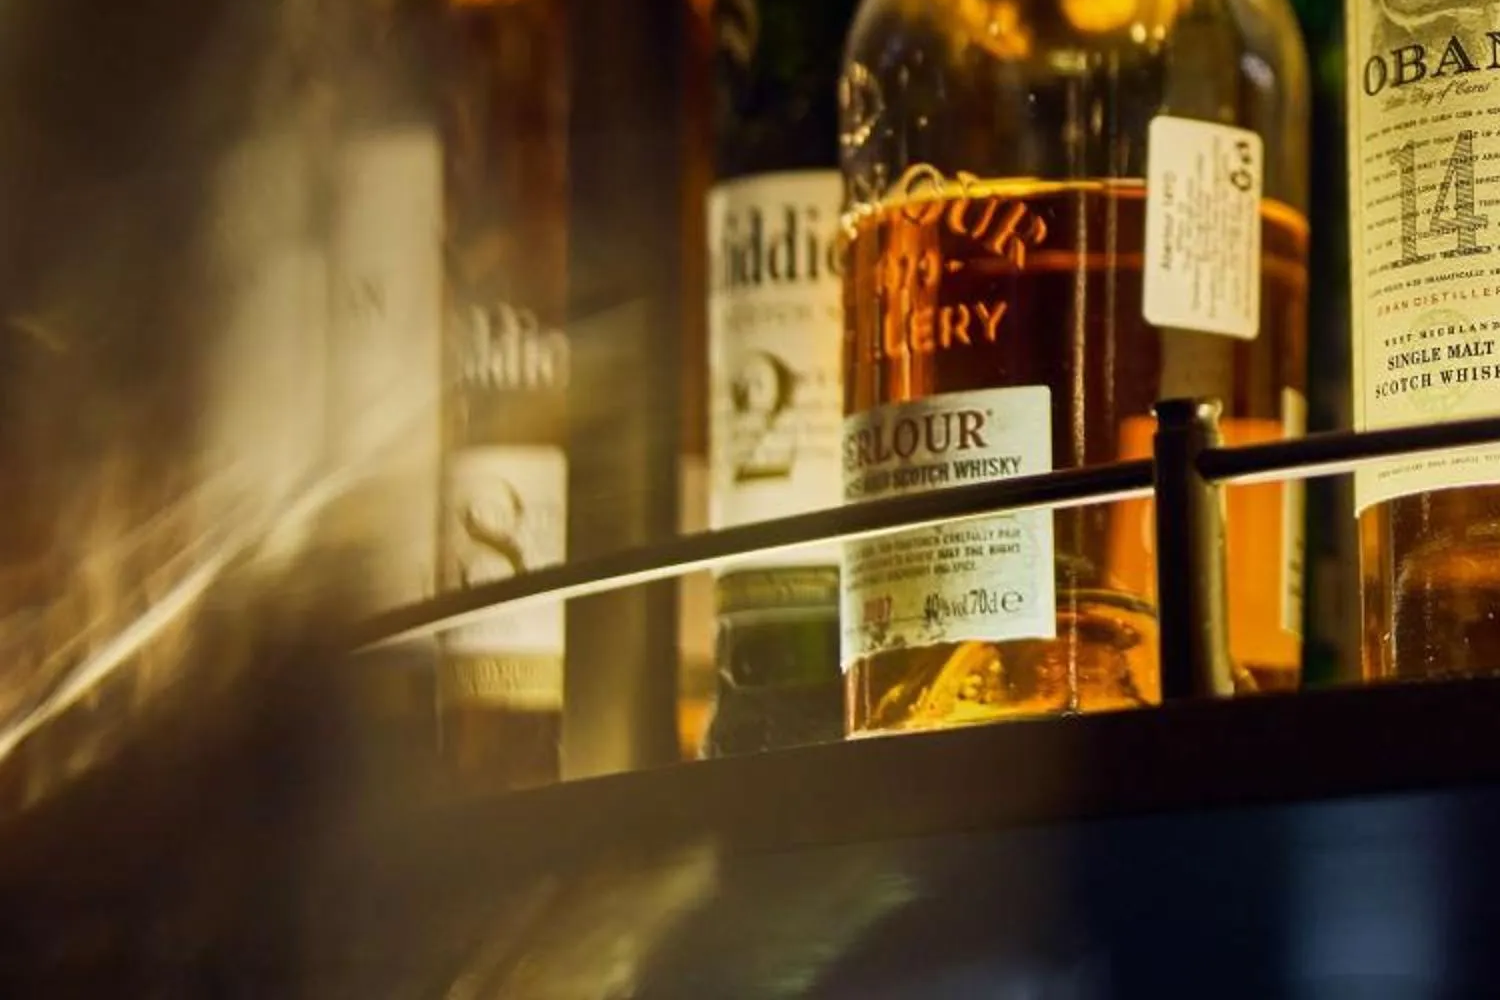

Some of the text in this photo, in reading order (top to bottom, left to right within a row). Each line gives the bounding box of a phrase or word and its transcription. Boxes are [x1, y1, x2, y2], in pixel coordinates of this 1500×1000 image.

[1387, 339, 1496, 372] SINGLE MALT
[1374, 373, 1432, 400] SCOTCH
[952, 454, 1022, 480] WHISKY
